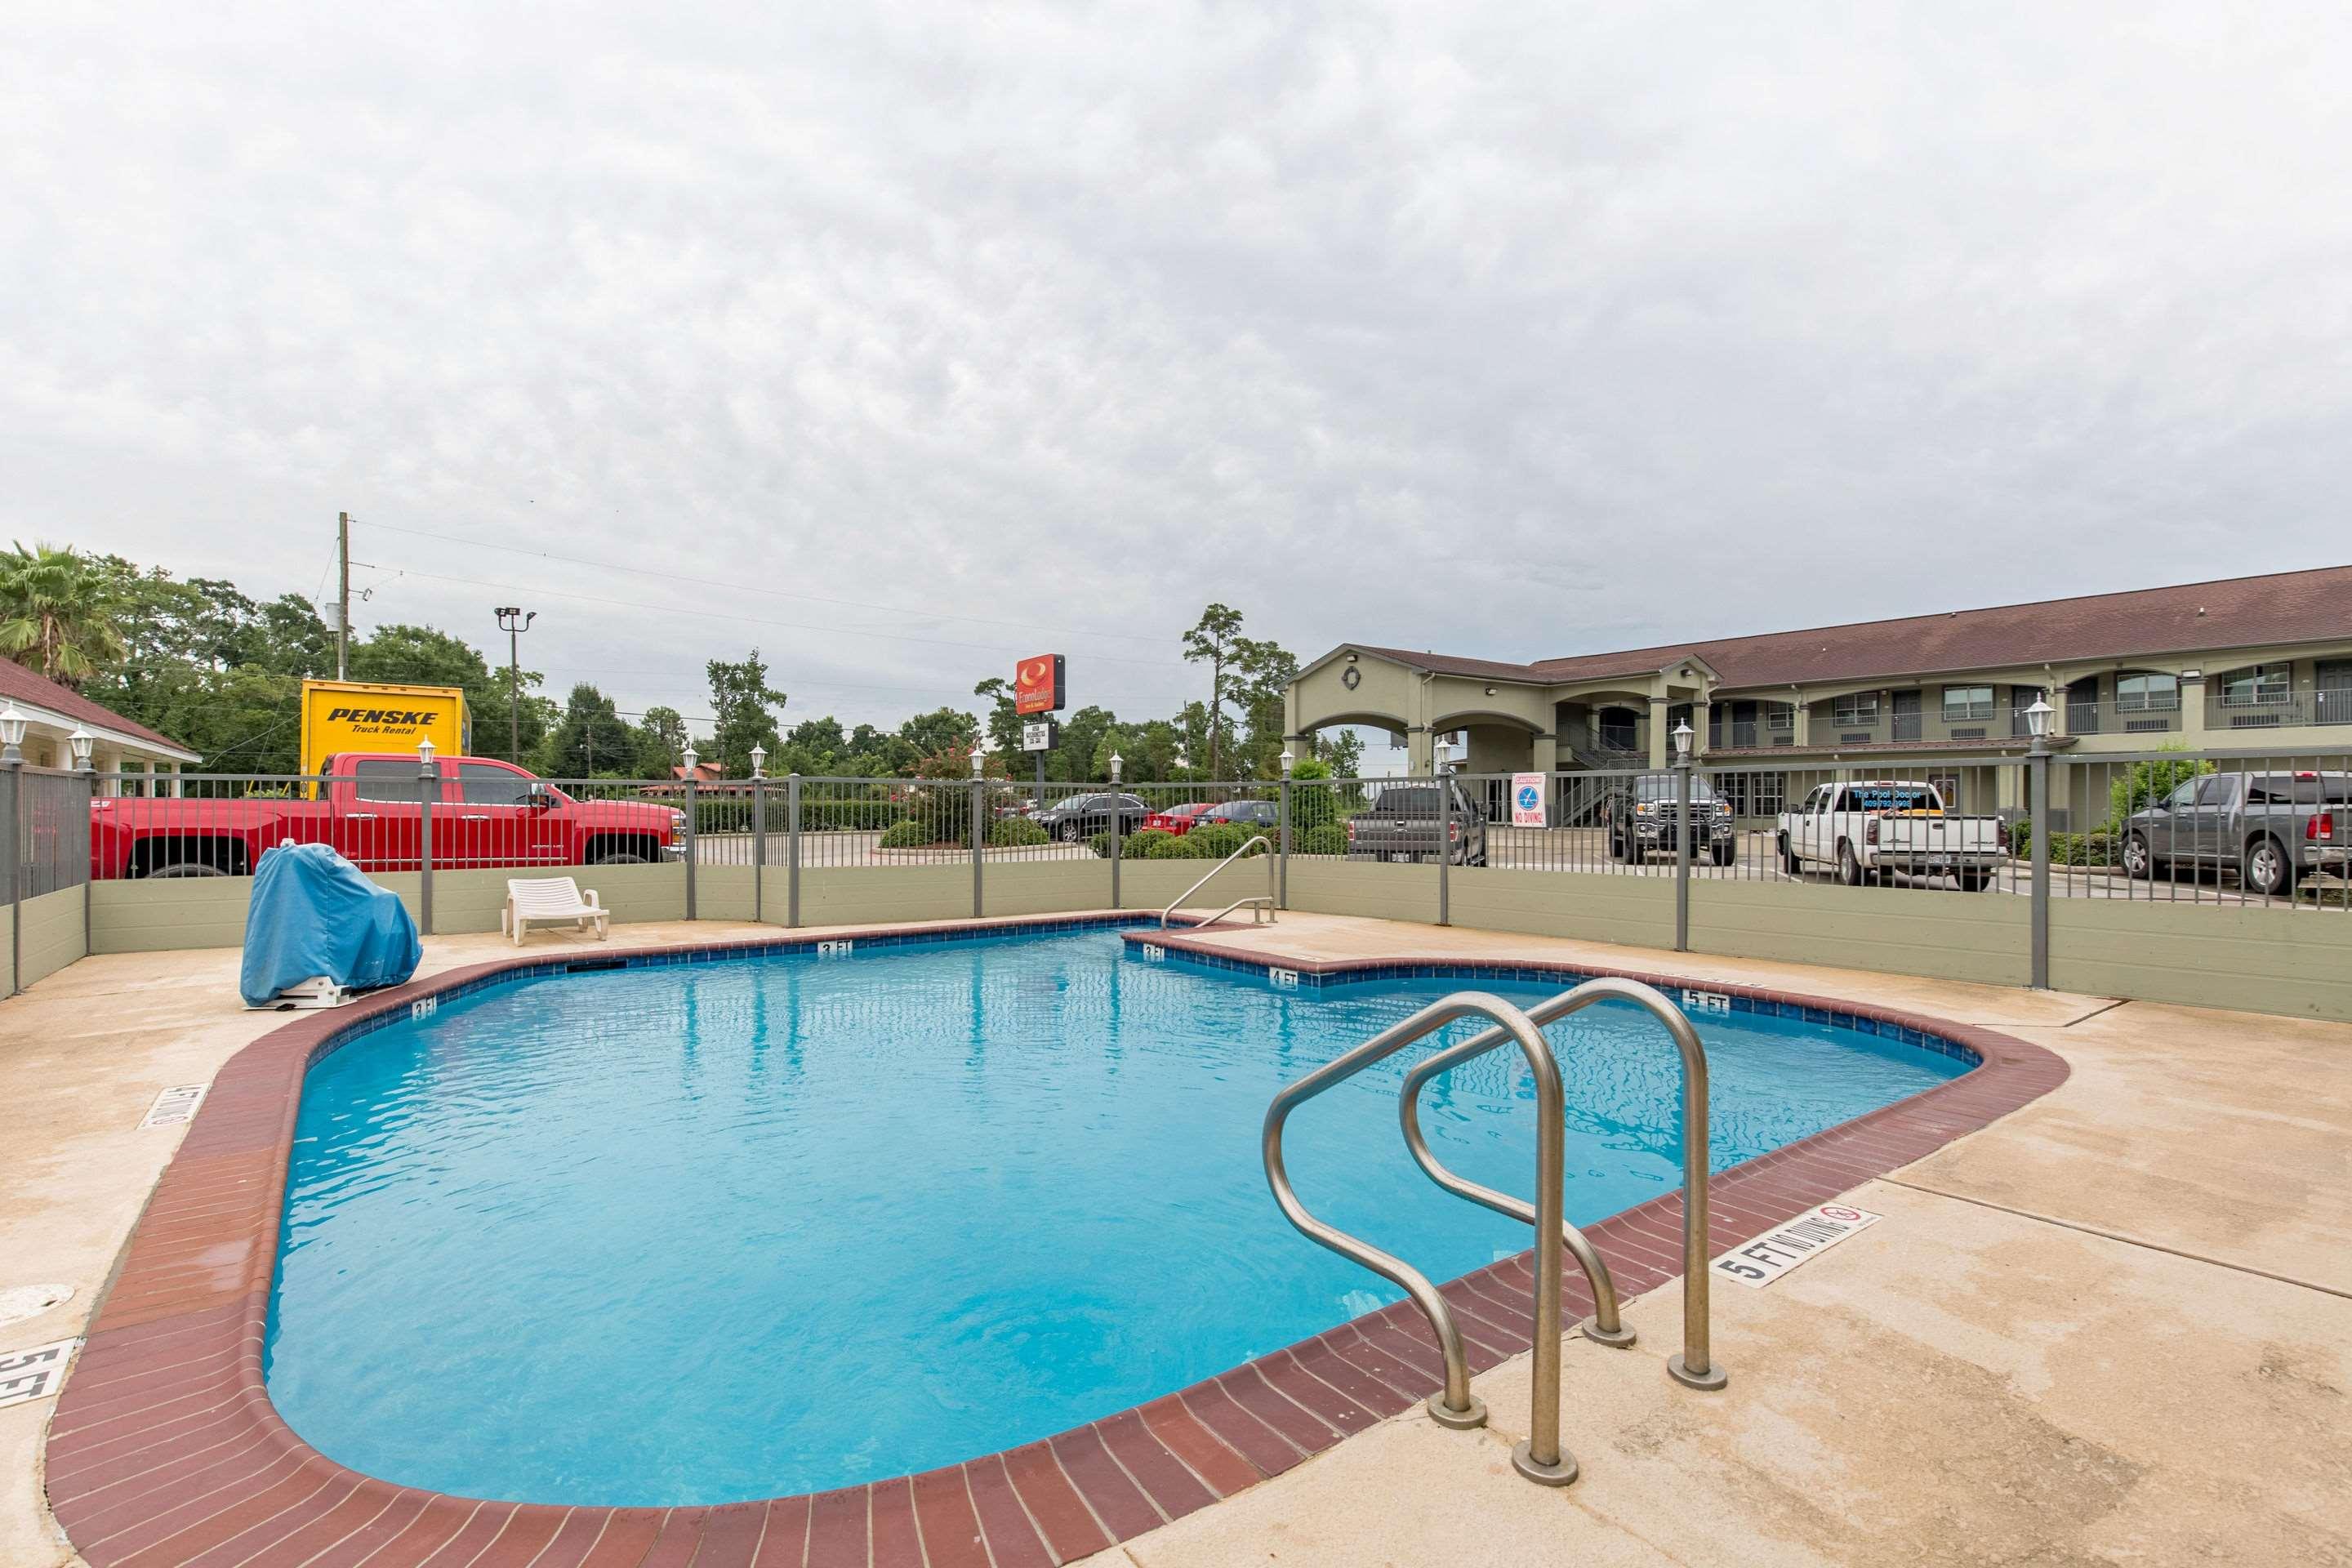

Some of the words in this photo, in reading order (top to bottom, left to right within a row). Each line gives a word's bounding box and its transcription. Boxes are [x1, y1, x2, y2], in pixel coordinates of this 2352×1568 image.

[327, 708, 439, 725] PENSKE
[352, 724, 379, 733] Truck
[382, 725, 416, 735] Rental
[1854, 790, 1869, 799] The
[1894, 790, 1921, 799] Docor
[836, 940, 851, 954] FT
[1155, 945, 1164, 956] FT
[1285, 973, 1297, 985] FT
[1689, 991, 1699, 1004] 5
[1707, 996, 1726, 1009] FT
[1784, 1217, 1851, 1243] DIVING
[1766, 1233, 1816, 1253] NO
[1740, 1241, 1797, 1267] FT
[1717, 1259, 1766, 1280] 5
[0, 1347, 60, 1373] 5
[0, 1370, 51, 1400] FT
